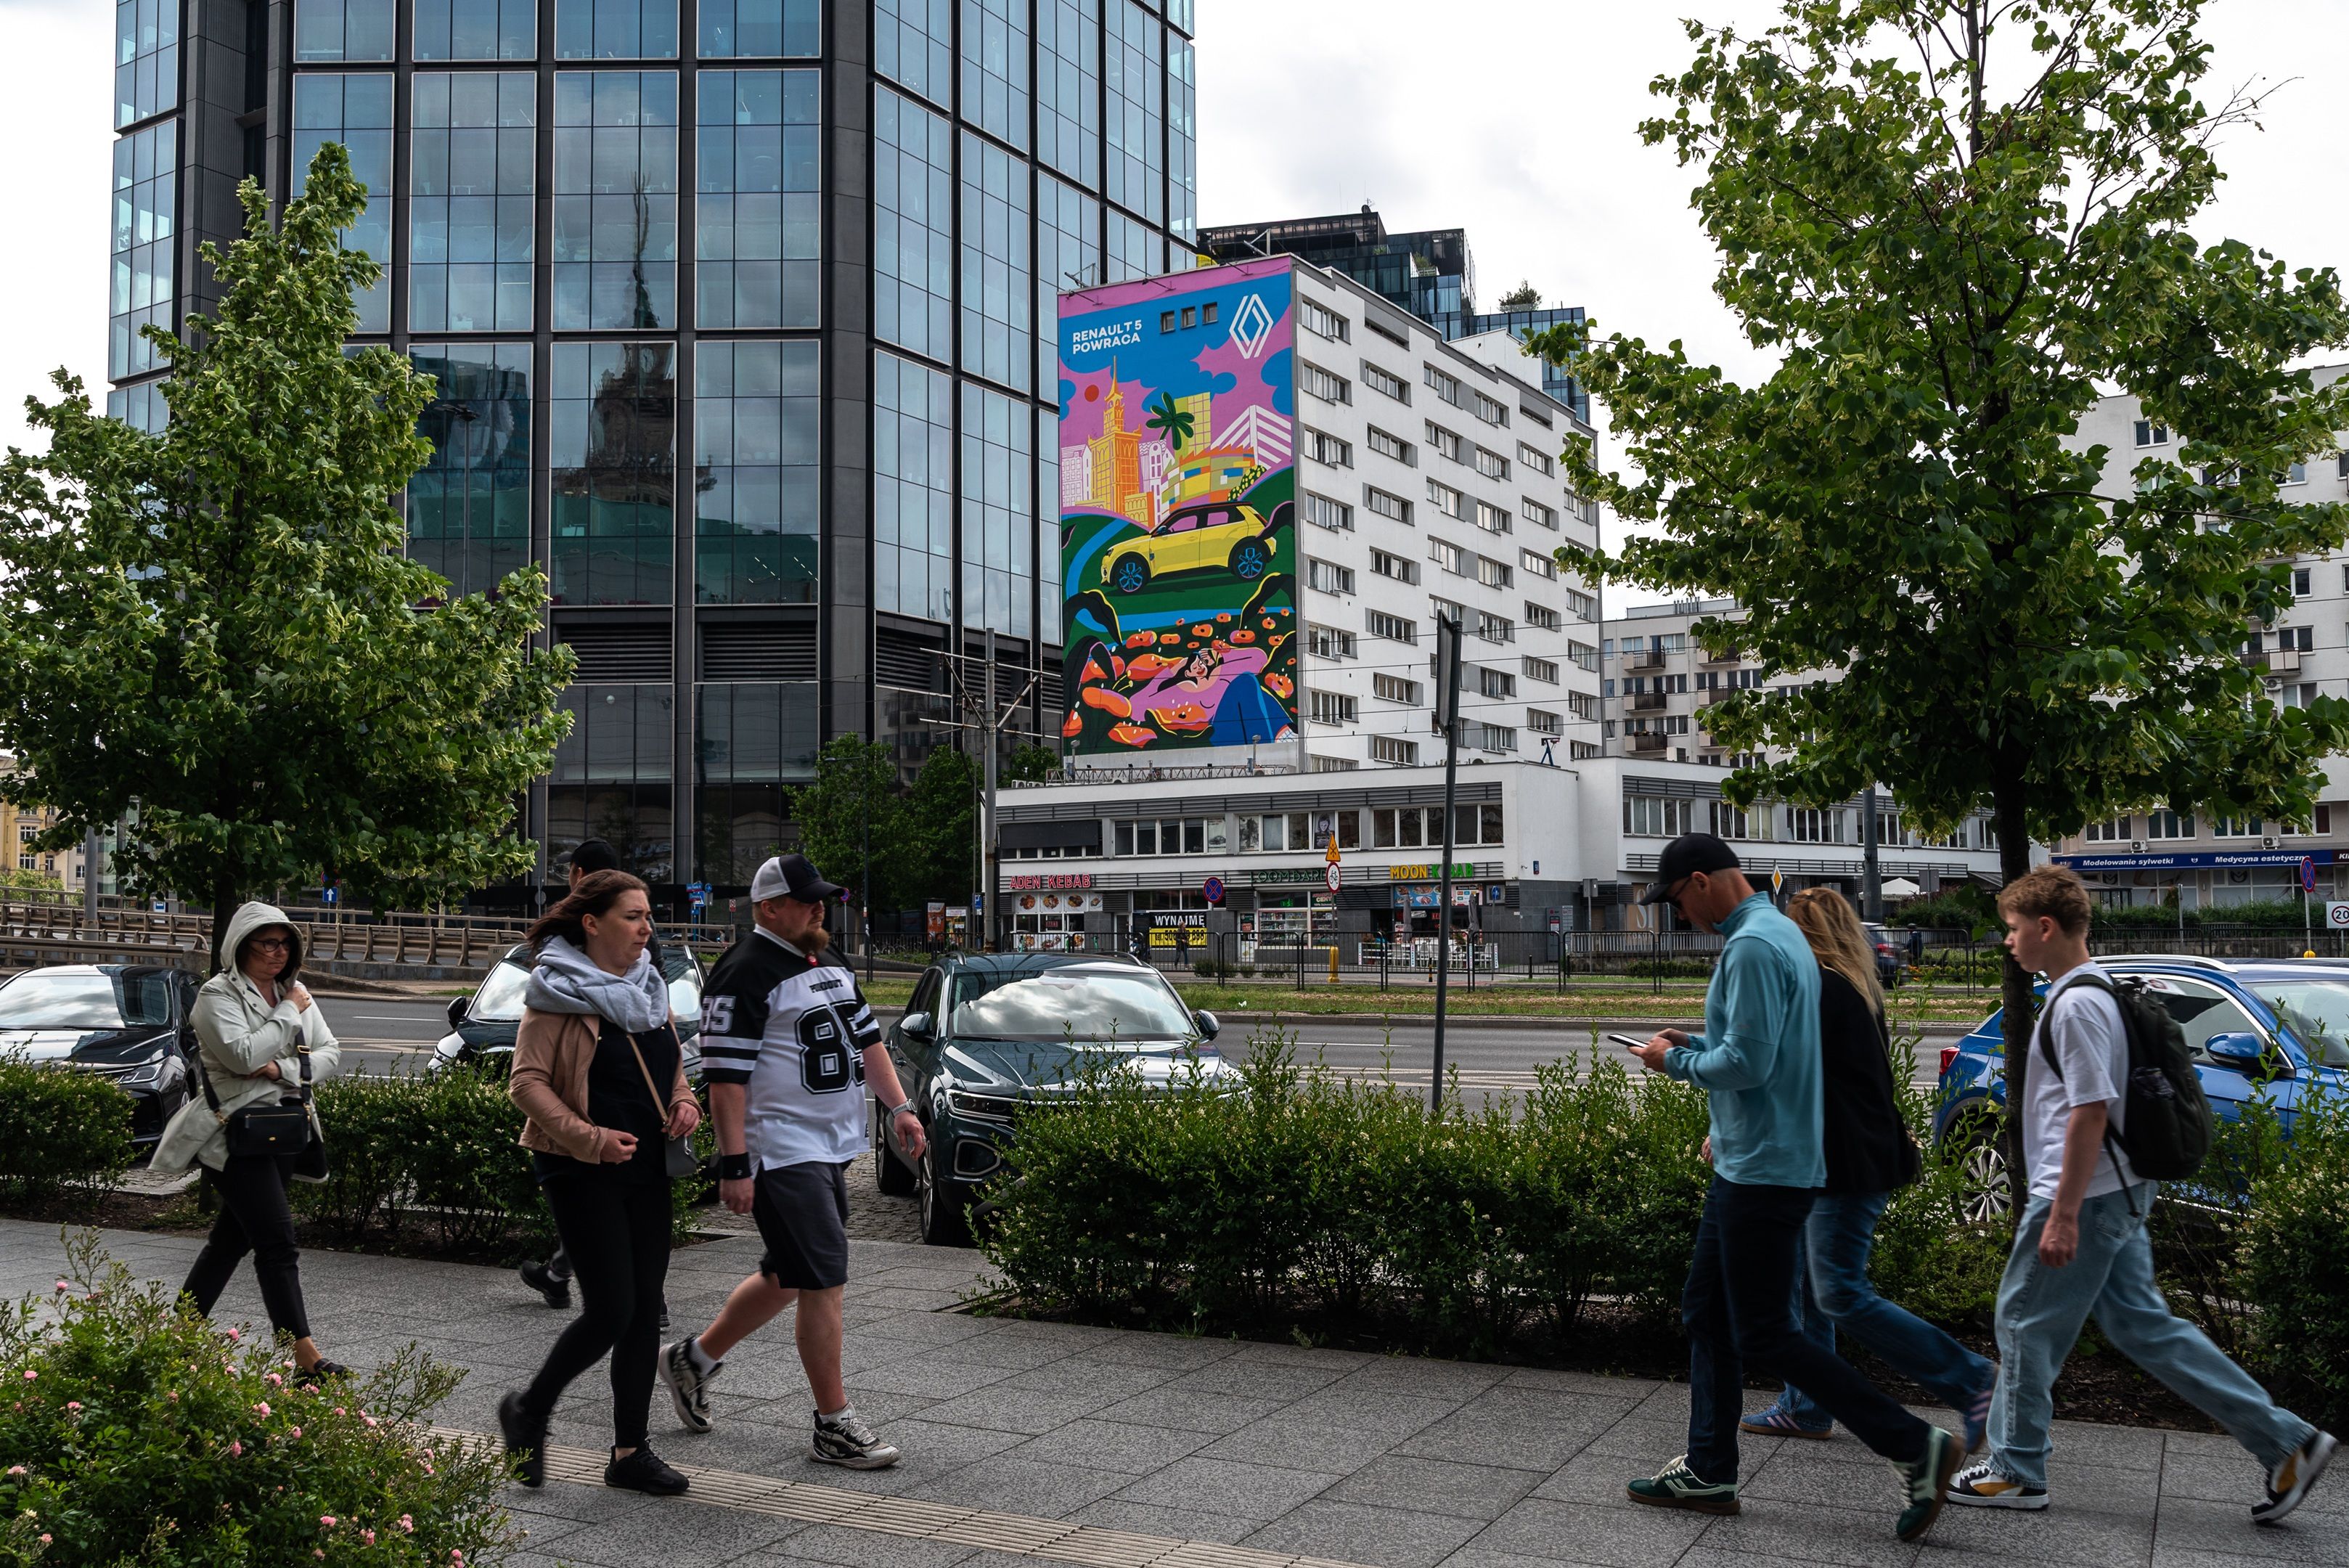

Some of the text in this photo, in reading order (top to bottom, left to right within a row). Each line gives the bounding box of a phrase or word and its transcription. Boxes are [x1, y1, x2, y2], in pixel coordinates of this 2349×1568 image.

[1073, 319, 1143, 343] RENAULT 5
[1073, 332, 1141, 355] POWRACA
[1390, 865, 1428, 880] MOON
[1010, 873, 1091, 889] ADEN KEBAB
[1155, 915, 1205, 928] WYNAJMĘ
[2335, 910, 2349, 920] 20
